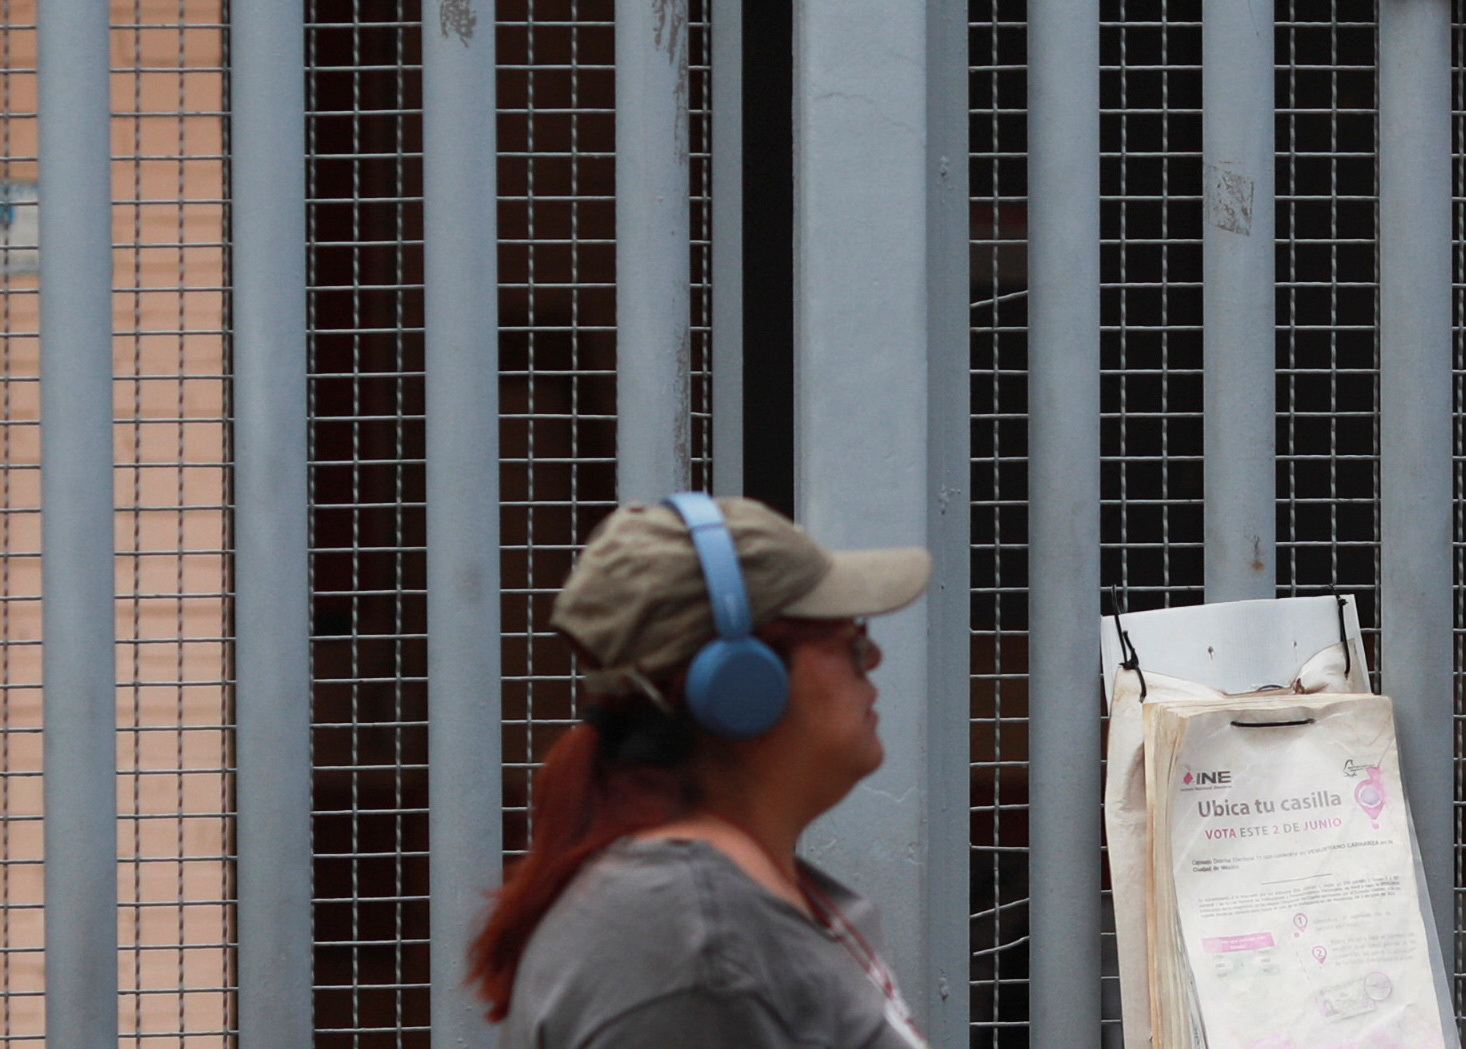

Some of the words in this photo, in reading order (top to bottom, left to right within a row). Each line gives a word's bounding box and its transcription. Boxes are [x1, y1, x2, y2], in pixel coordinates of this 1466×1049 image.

[1196, 771, 1232, 785] INE
[1199, 799, 1250, 818] Ubica
[1255, 800, 1275, 815] tu
[1281, 790, 1342, 812] casilla
[1205, 828, 1237, 840] VOTA
[1239, 825, 1268, 838] ESTE
[1273, 825, 1279, 835] 2
[1283, 822, 1300, 834] DE
[1302, 818, 1342, 831] JUNIO
